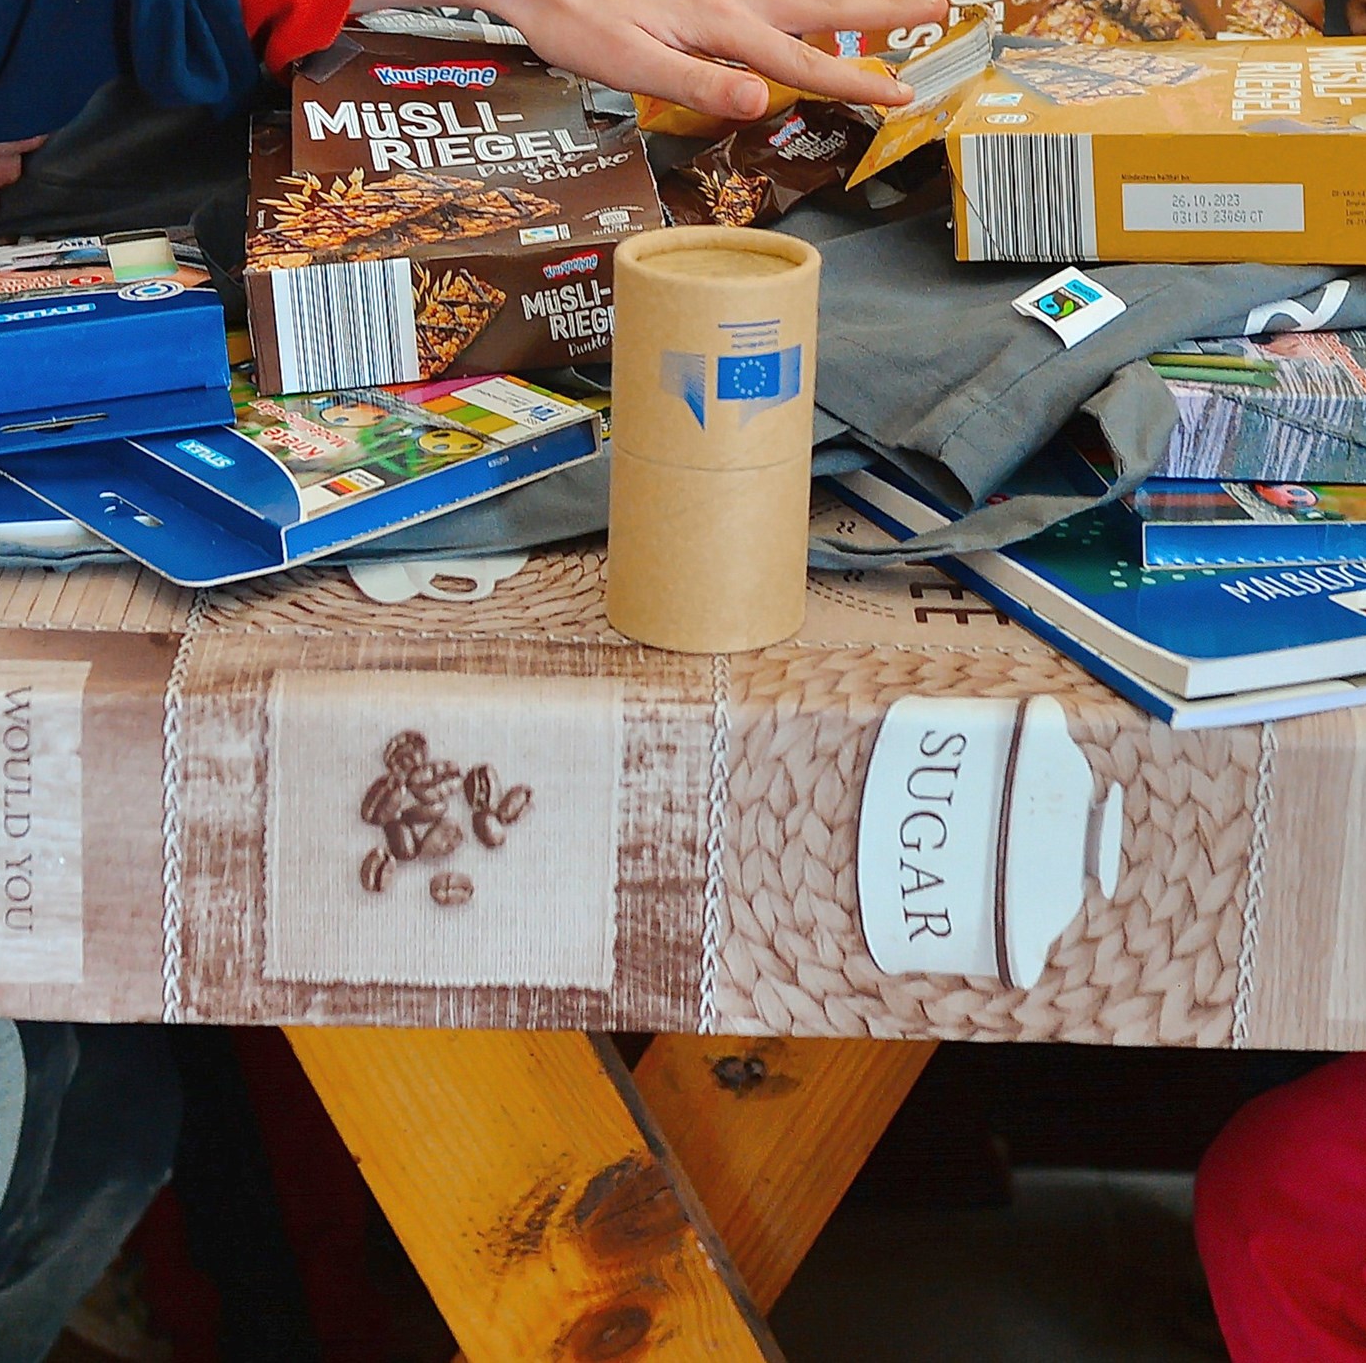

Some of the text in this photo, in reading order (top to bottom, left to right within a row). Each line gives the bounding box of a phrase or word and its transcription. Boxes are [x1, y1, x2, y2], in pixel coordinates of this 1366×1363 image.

[375, 65, 498, 87] Knusperone
[1232, 62, 1302, 121] RIEGEL
[368, 128, 598, 173] RIEGEL
[1172, 193, 1241, 208] 26.10.2023
[262, 426, 325, 461] Knete
[3, 685, 34, 933] WOULD YOU
[899, 729, 967, 944] SUGAR
